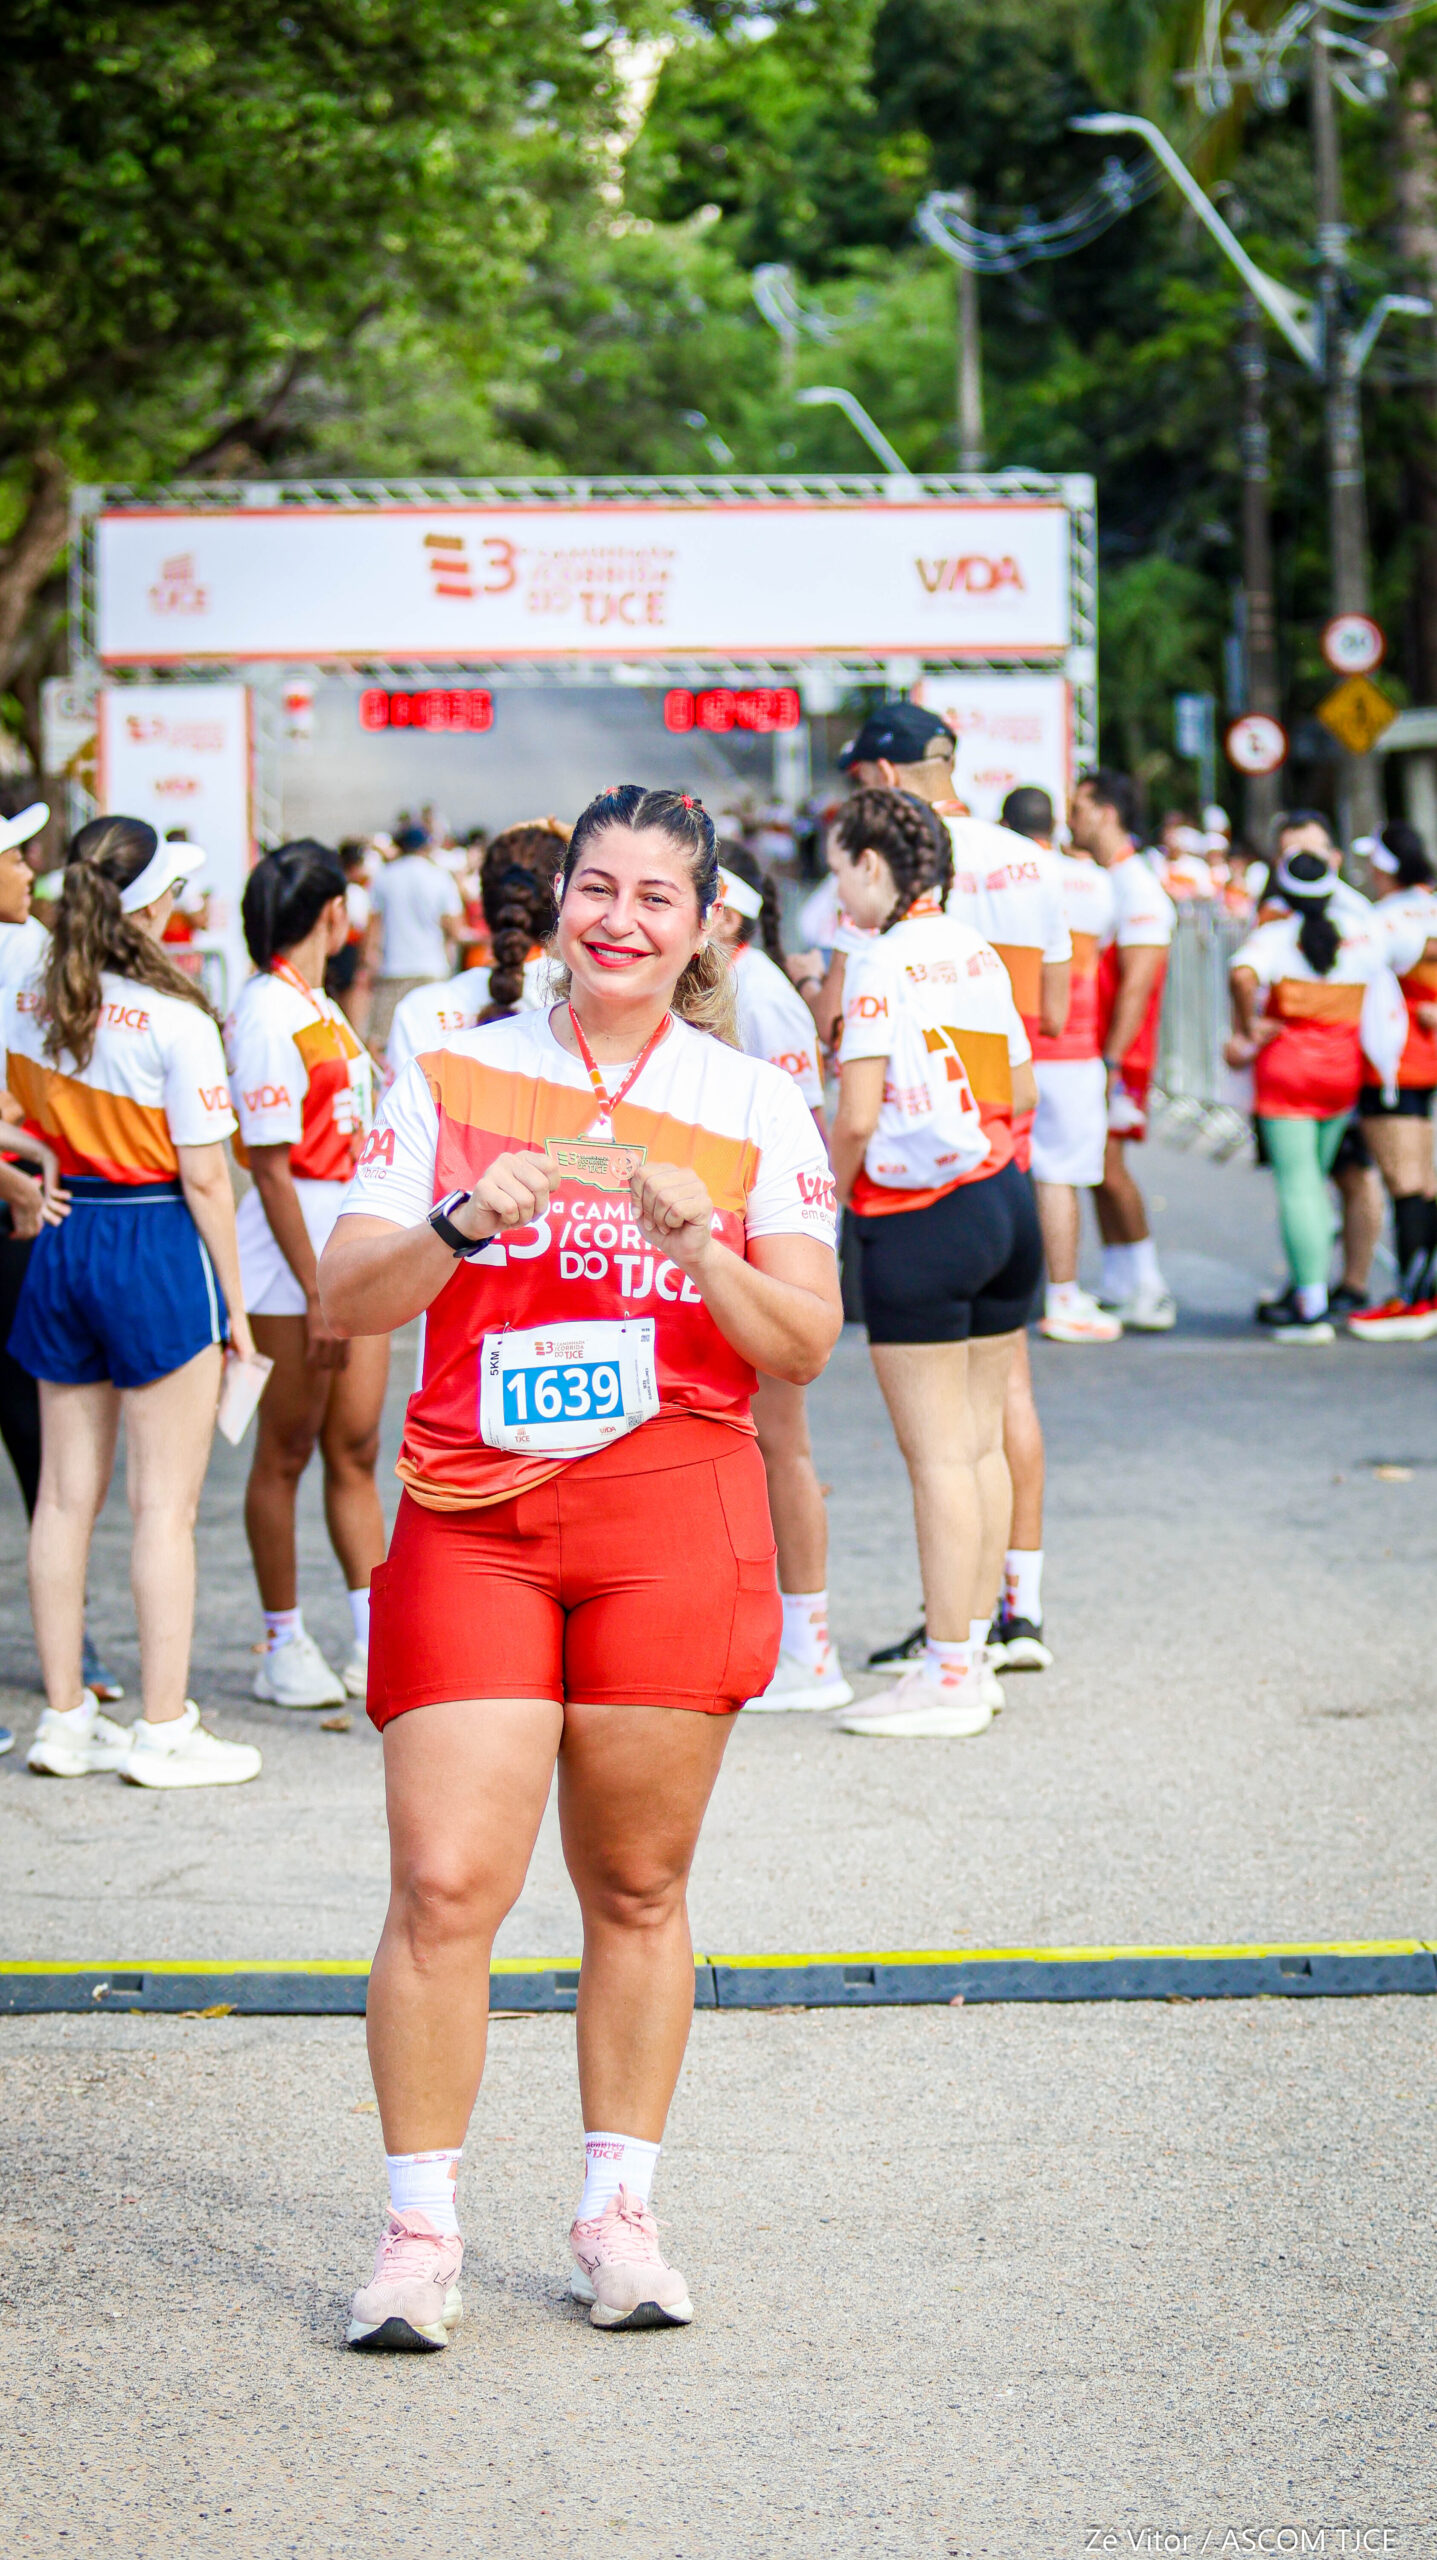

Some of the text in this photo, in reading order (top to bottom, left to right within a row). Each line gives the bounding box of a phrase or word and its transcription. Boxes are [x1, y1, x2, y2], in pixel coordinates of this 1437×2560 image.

[107, 1003, 149, 1030] TJCE
[242, 1086, 291, 1111] VIDA
[801, 1209, 819, 1220] em
[559, 1251, 702, 1304] DO TJCE
[490, 1351, 500, 1376] 5KM
[565, 1350, 584, 1359] TJCE
[507, 1365, 619, 1420] 1639
[593, 2149, 623, 2161] TJCE
